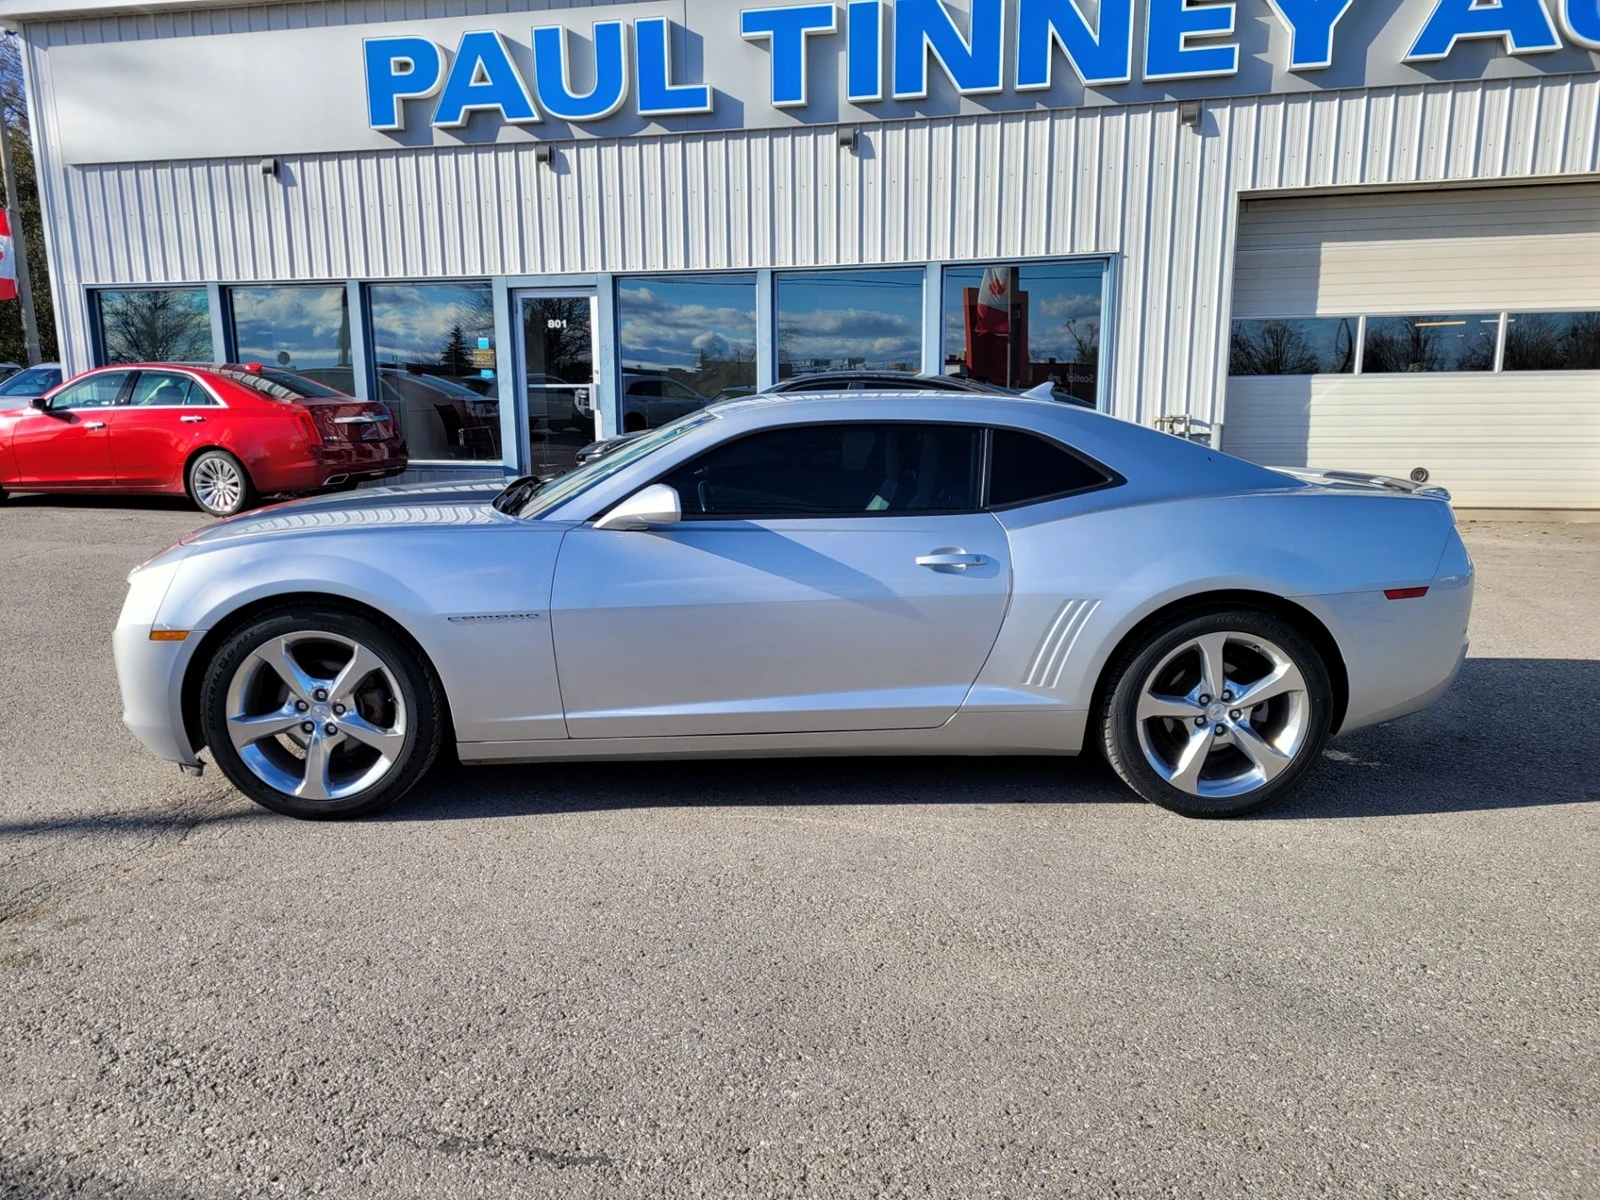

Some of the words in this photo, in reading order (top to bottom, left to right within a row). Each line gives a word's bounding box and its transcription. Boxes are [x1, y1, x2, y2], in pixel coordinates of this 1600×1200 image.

[362, 16, 713, 130] PAUL
[740, 0, 1355, 107] TINNEY
[1400, 0, 1600, 63] A
[547, 319, 567, 329] 801
